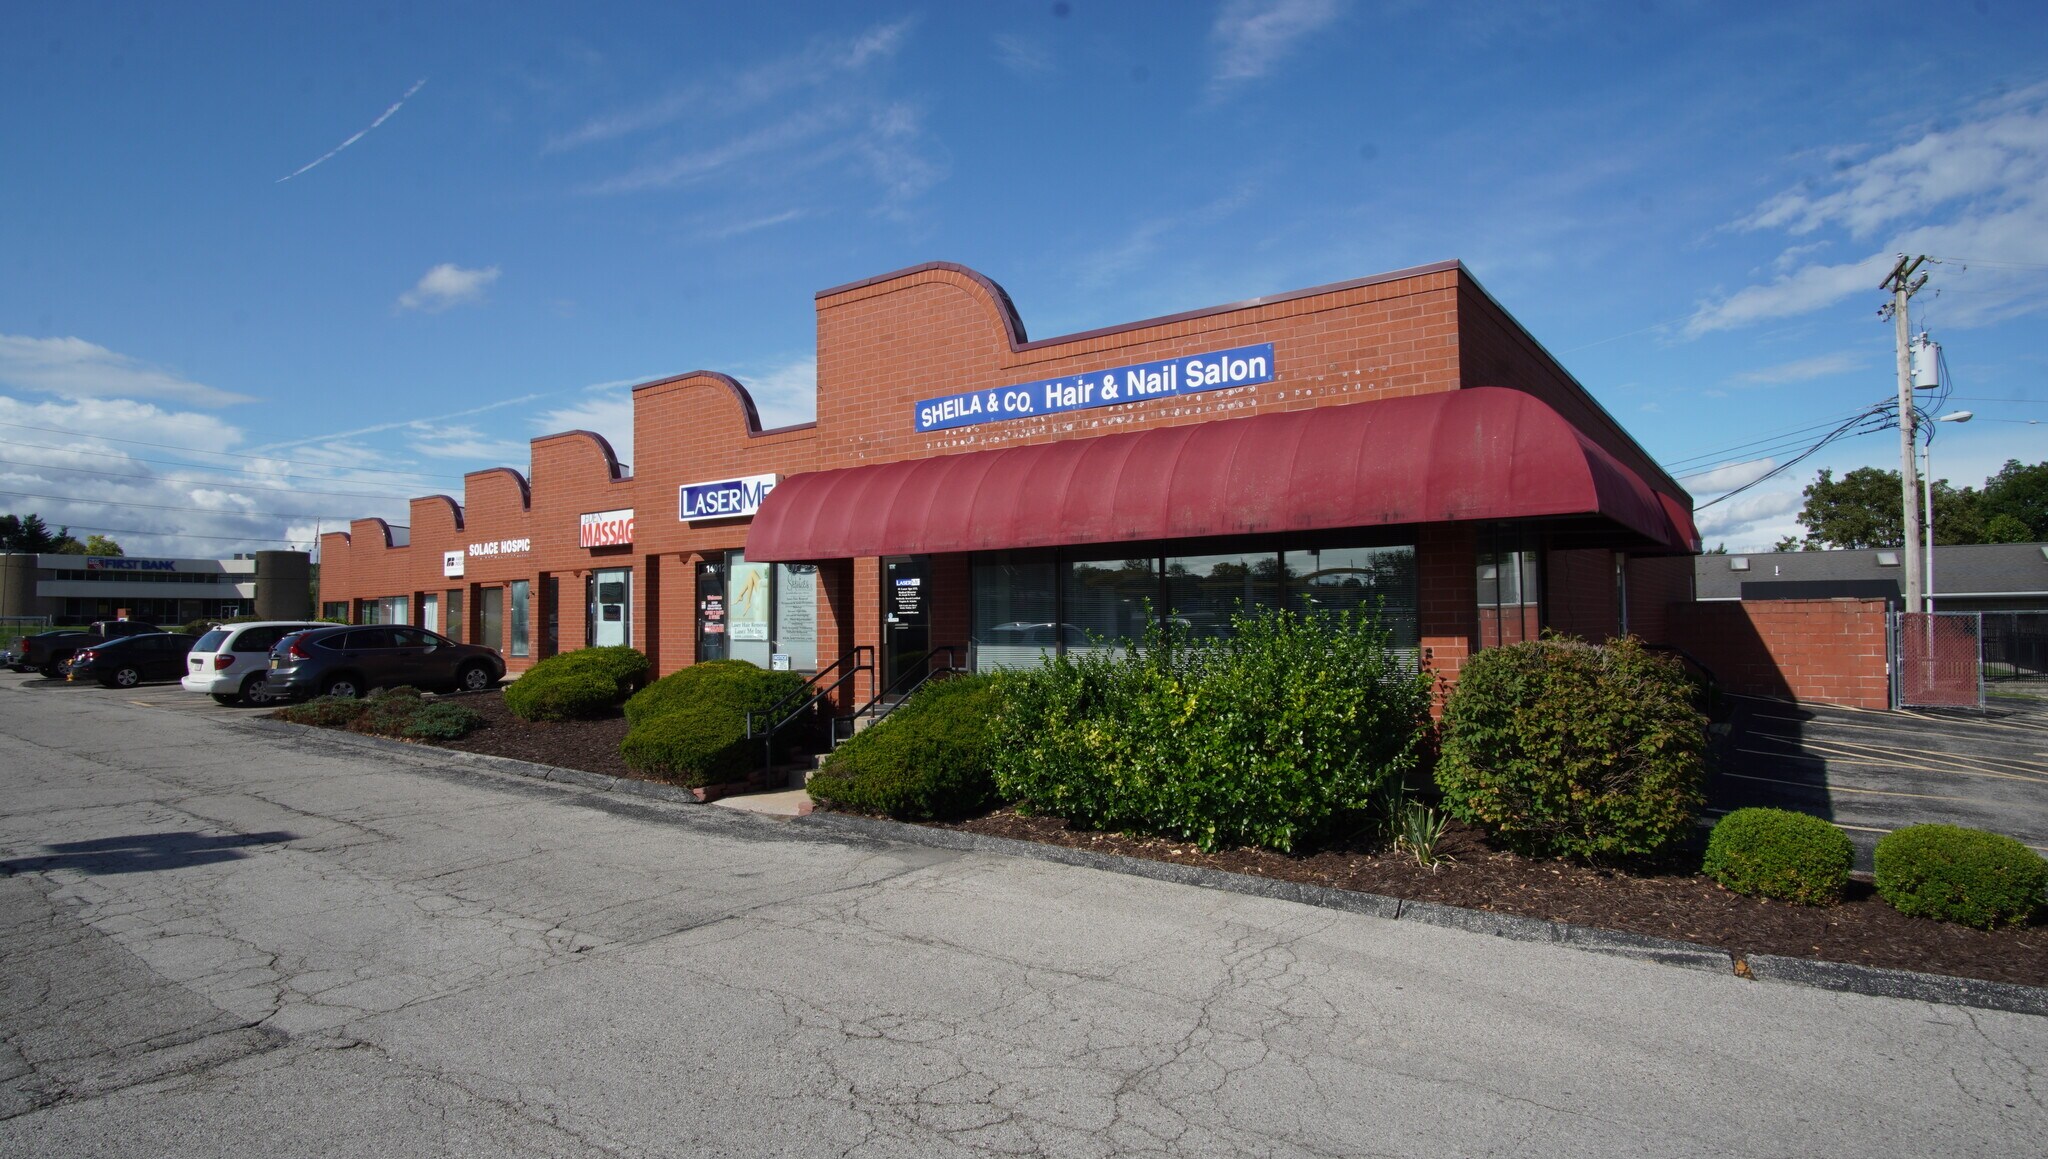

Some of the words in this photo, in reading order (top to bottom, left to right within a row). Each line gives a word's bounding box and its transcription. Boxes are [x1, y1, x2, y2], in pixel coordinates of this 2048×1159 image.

[921, 395, 982, 428] SHEILA
[986, 392, 999, 413] &
[1003, 390, 1034, 413] CO.
[1045, 378, 1095, 409] Hair
[1100, 374, 1119, 401] &
[1127, 364, 1177, 397] Nail
[1186, 356, 1267, 388] Salon
[469, 541, 499, 557] SOLACE
[105, 559, 141, 570] FIRST
[141, 560, 176, 572] BANK
